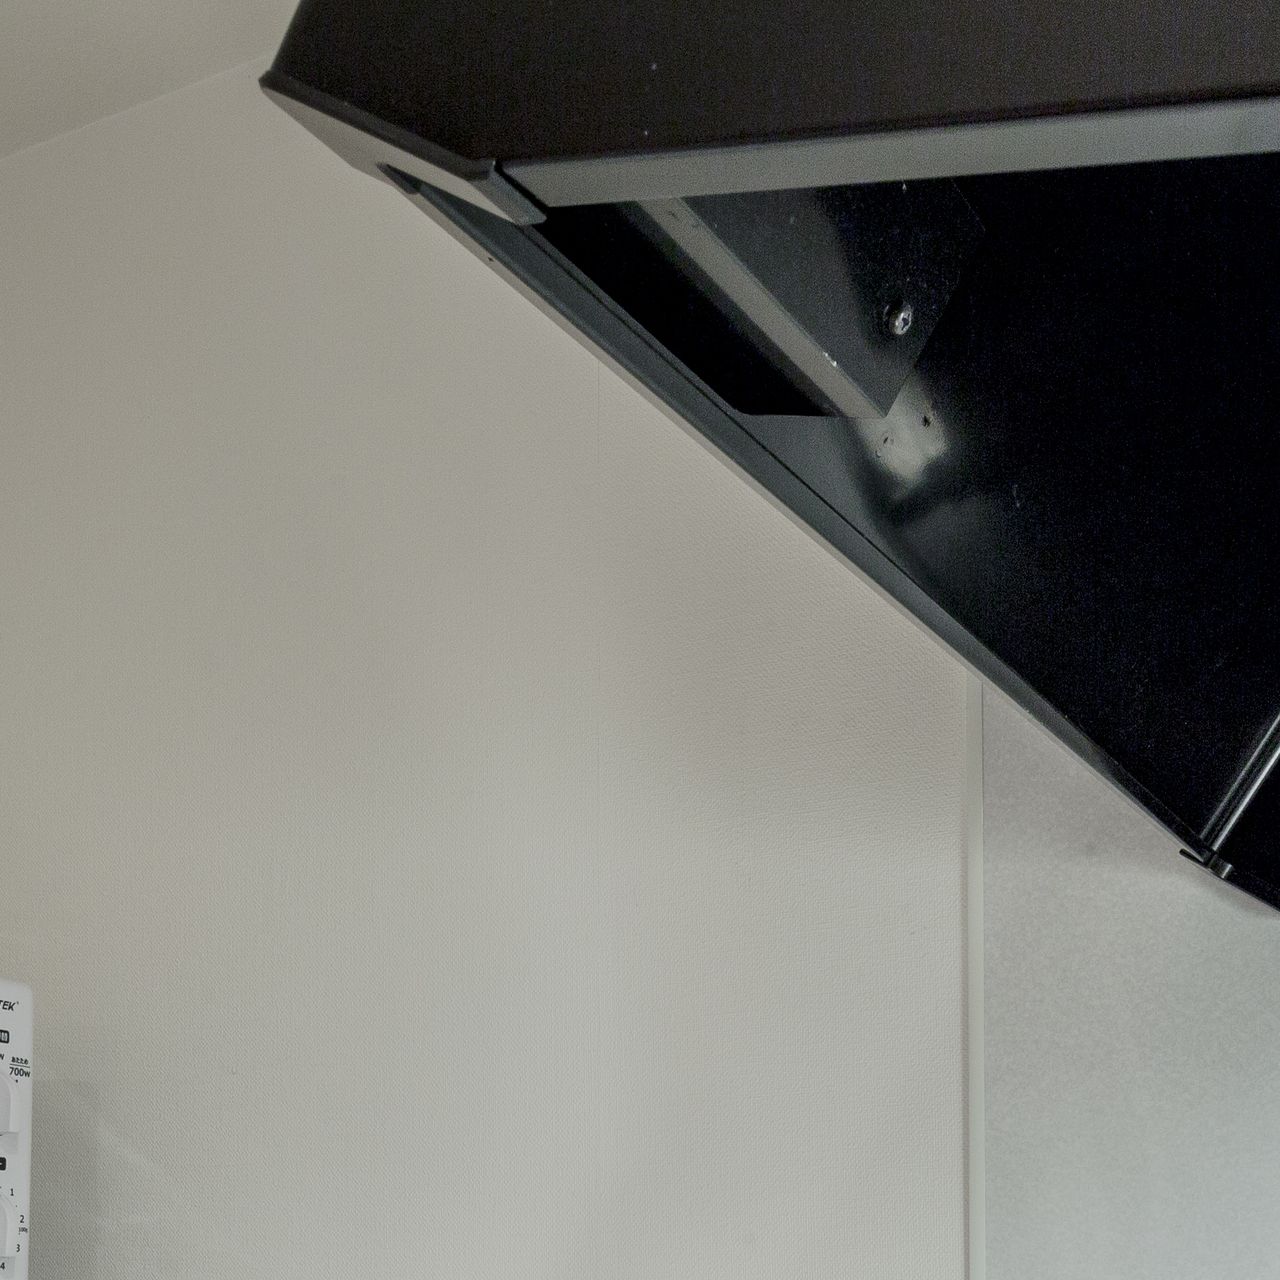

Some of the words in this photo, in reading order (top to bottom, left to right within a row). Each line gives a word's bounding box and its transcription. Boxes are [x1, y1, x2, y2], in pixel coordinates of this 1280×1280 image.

[19, 1215, 25, 1223] 2
[16, 1244, 21, 1252] 3
[0, 1262, 6, 1270] 4
